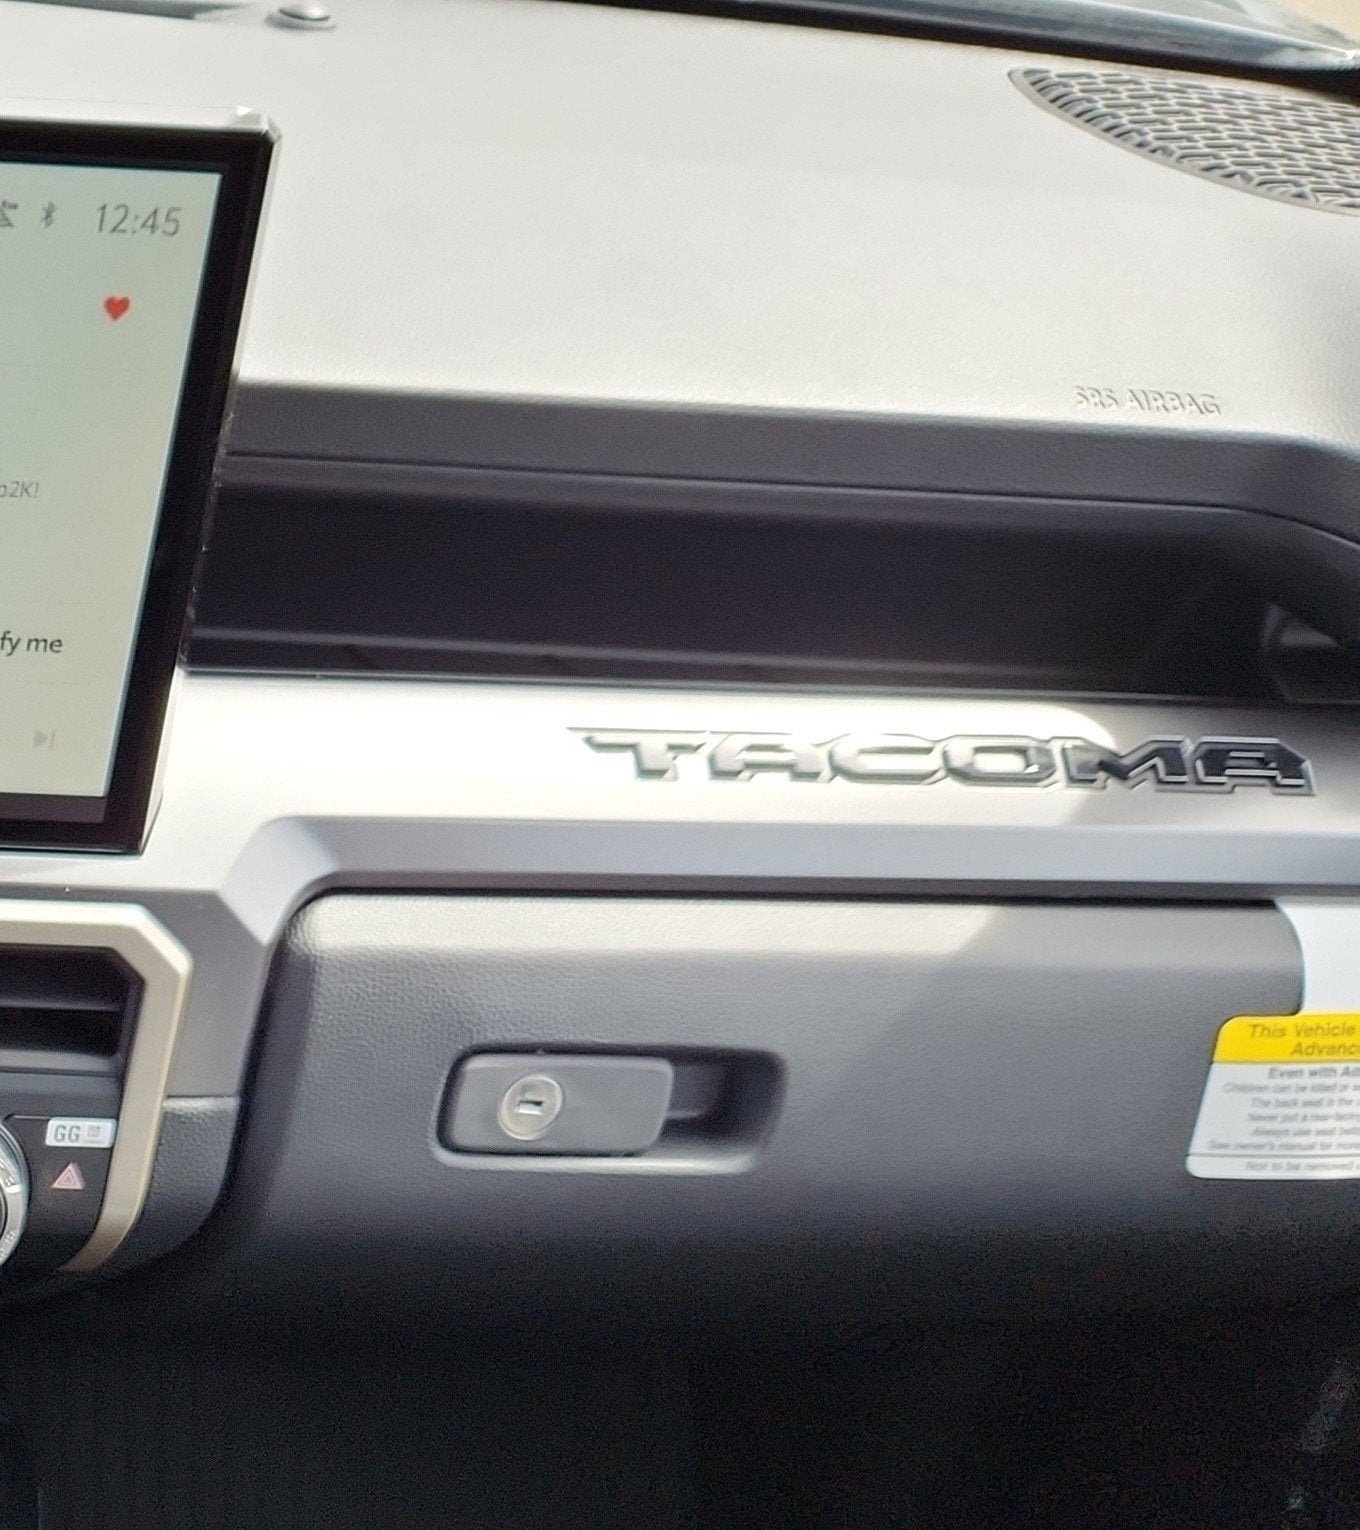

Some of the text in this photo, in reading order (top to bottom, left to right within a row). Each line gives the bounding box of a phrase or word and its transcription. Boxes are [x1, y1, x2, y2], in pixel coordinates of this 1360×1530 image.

[95, 203, 182, 237] 12:45
[1073, 385, 1222, 416] SRS AIRBAG
[25, 636, 63, 655] me
[566, 726, 1318, 797] TACOMA
[1249, 1021, 1357, 1039] This Vehicle
[54, 1125, 81, 1143] GG
